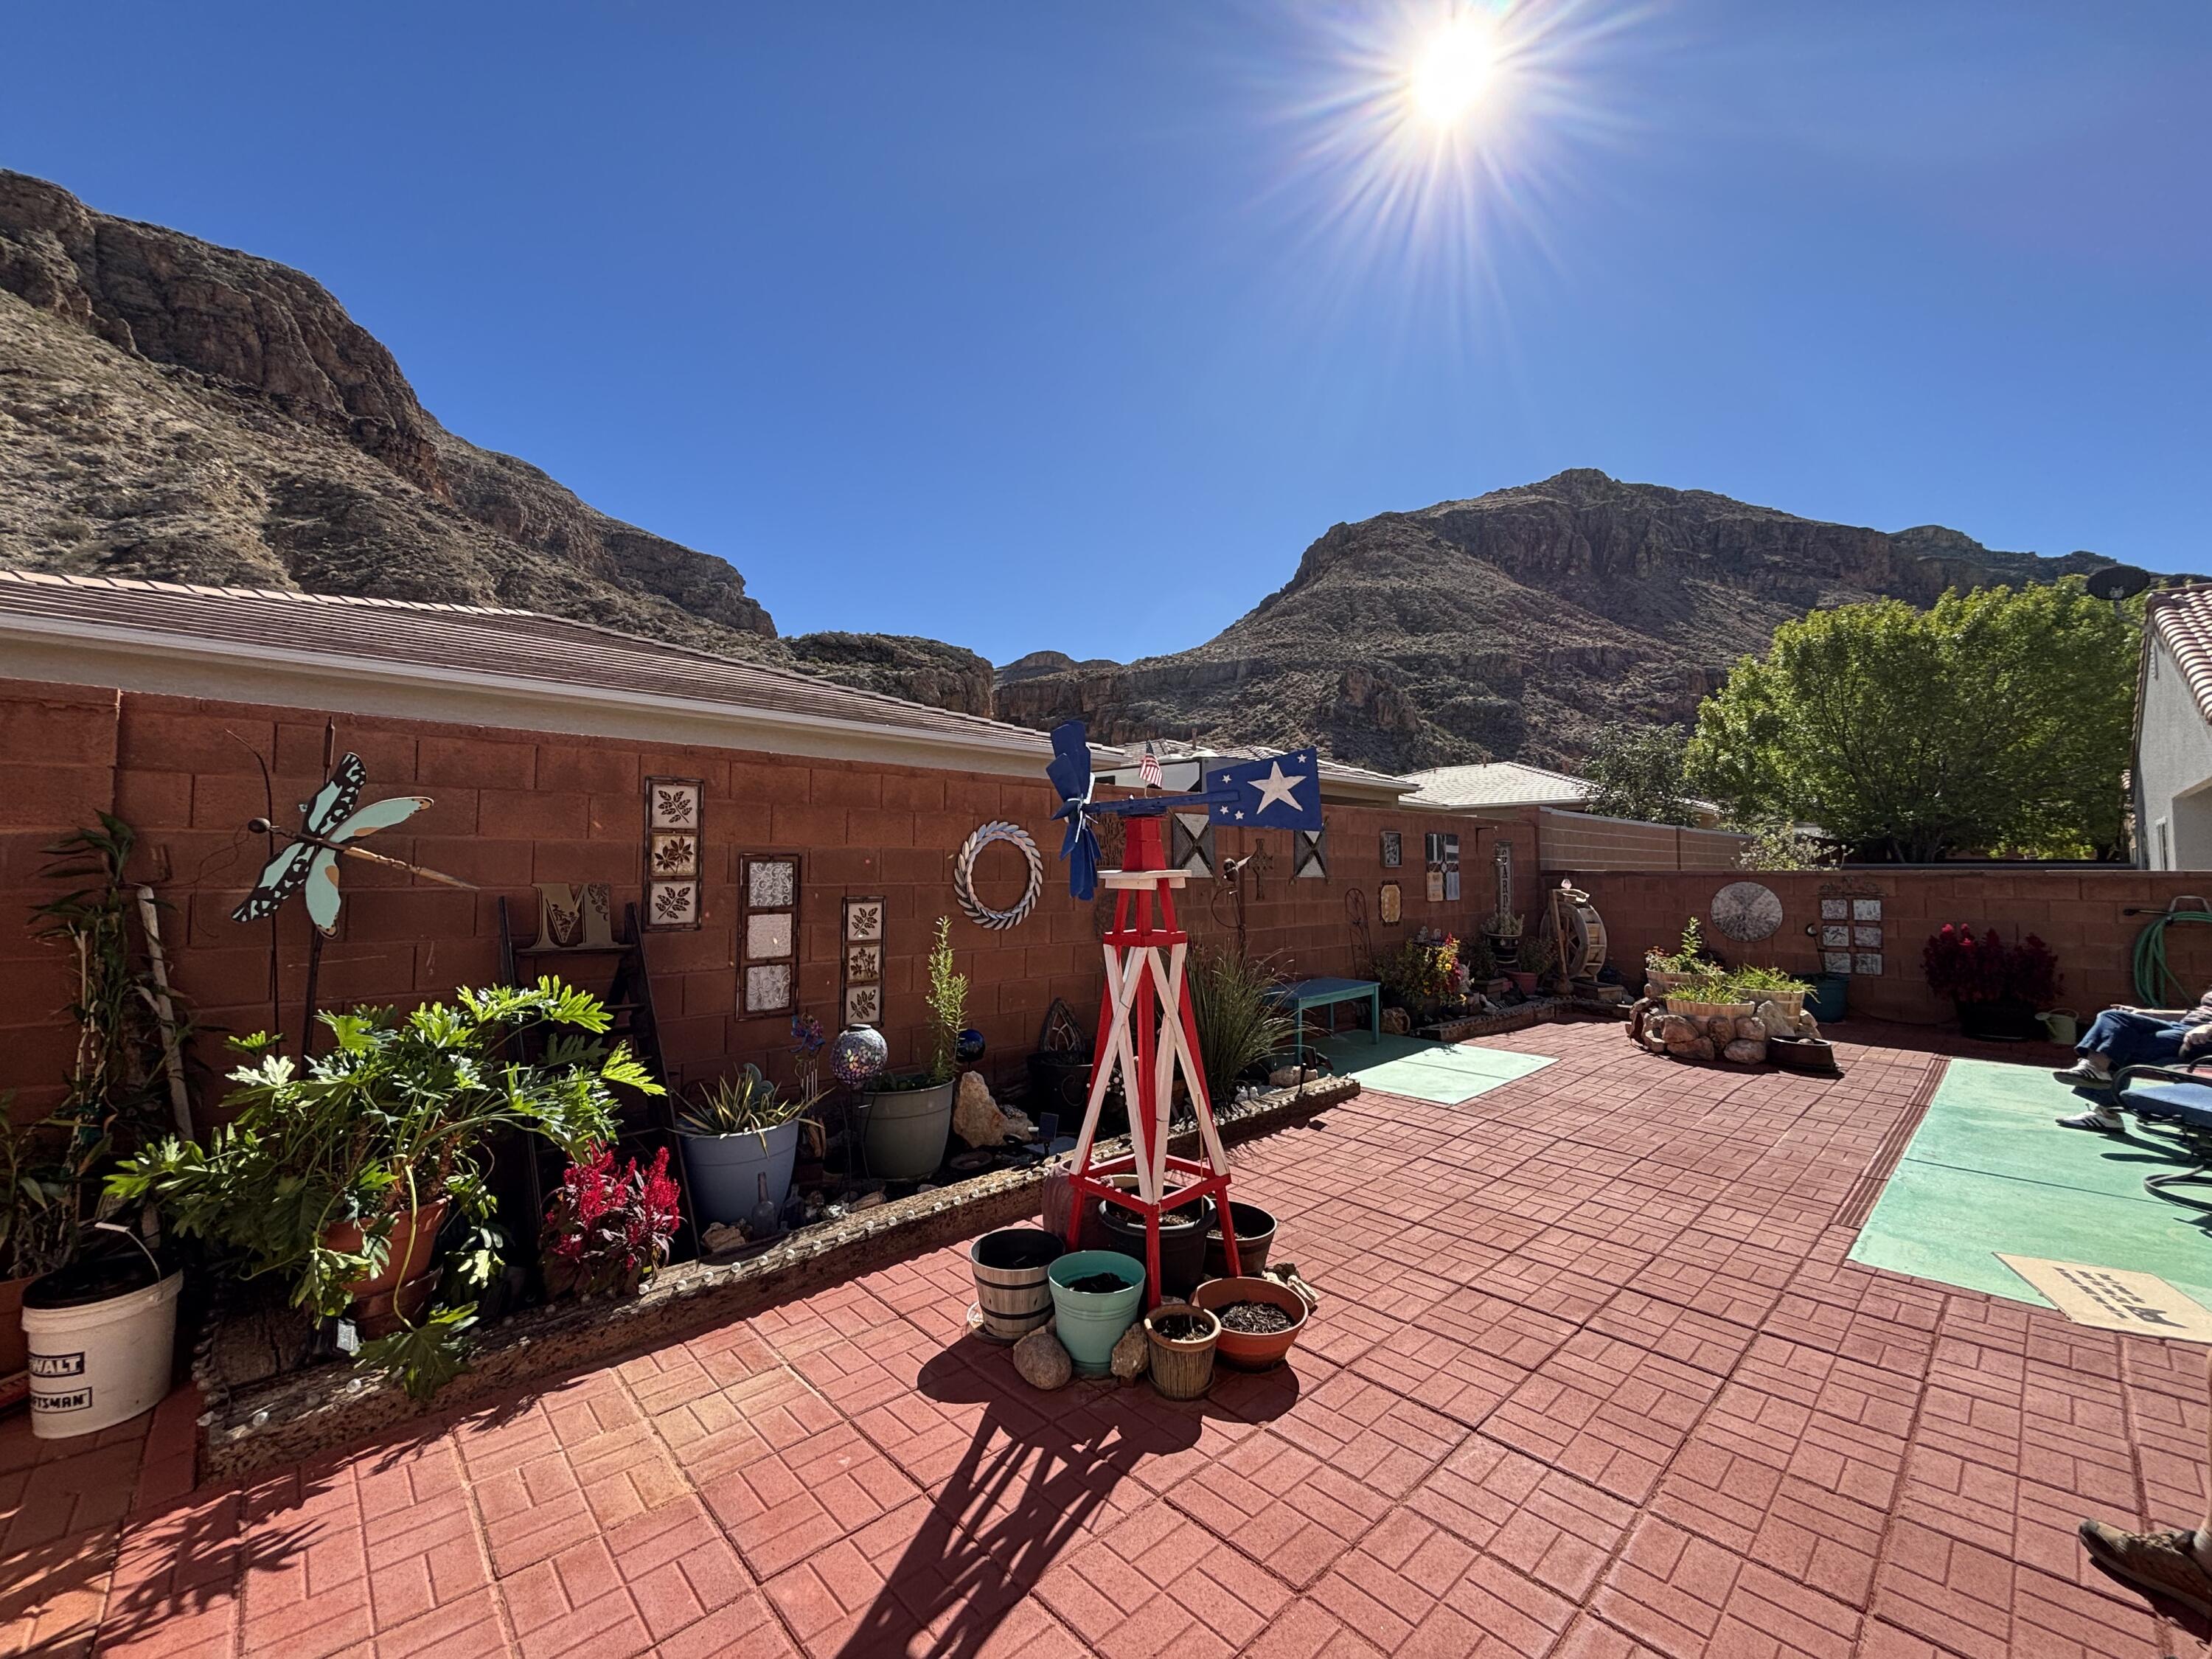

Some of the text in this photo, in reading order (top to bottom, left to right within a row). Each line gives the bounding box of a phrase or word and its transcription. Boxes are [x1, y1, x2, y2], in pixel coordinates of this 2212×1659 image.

[532, 883, 619, 949] M
[29, 1355, 81, 1374] WALT
[32, 1394, 84, 1409] TSMAN
